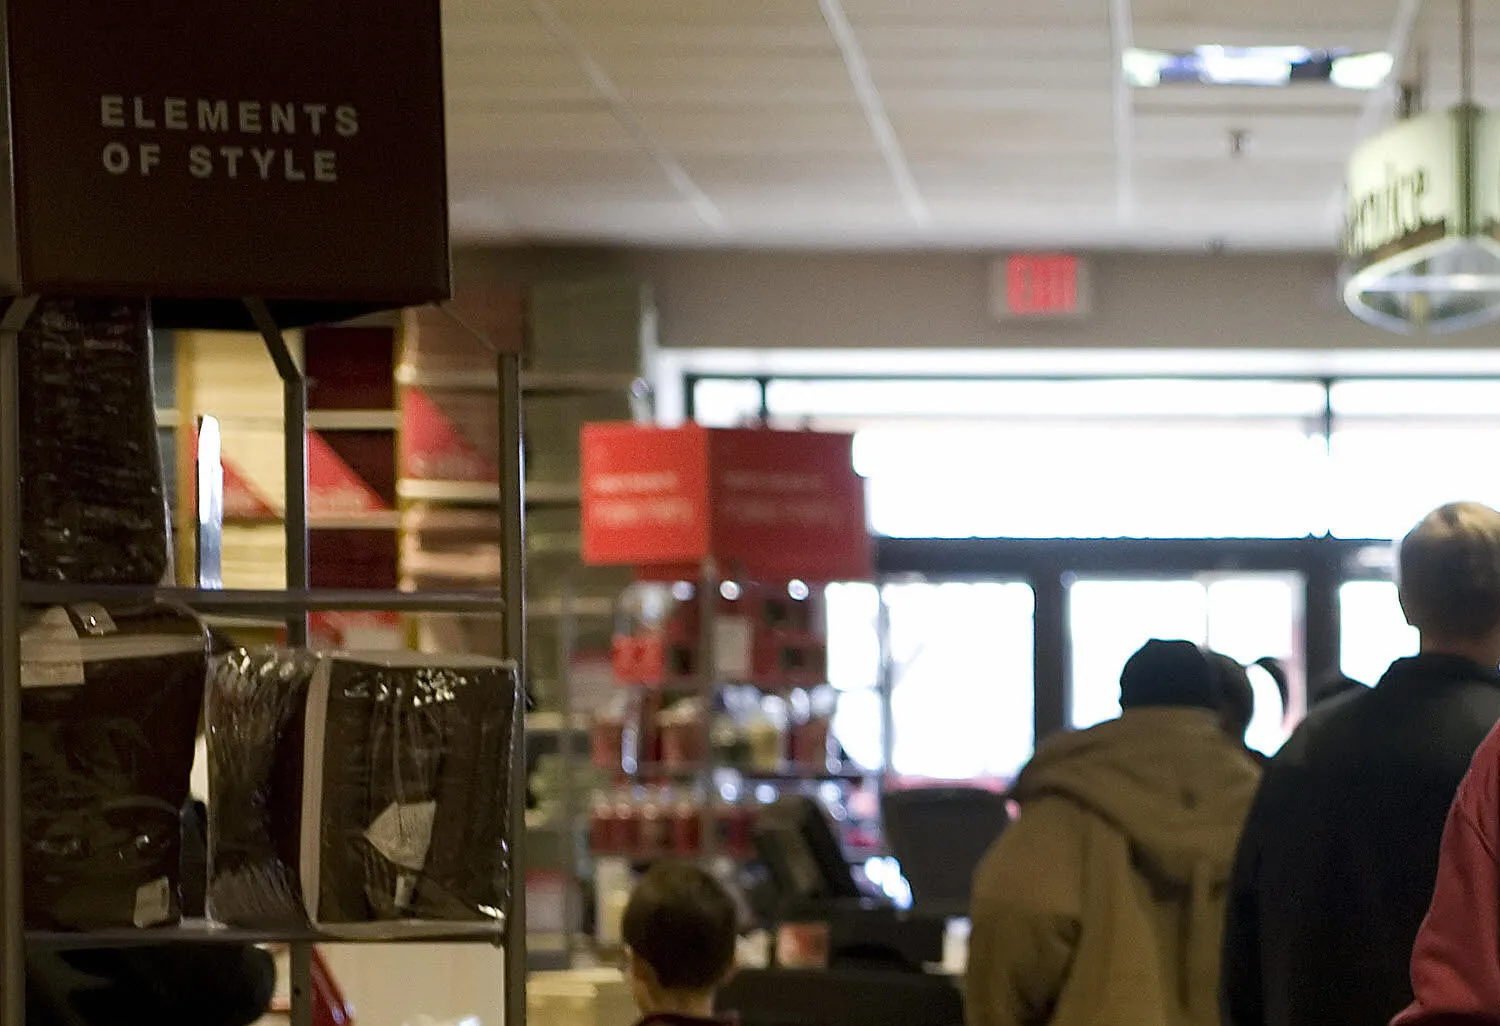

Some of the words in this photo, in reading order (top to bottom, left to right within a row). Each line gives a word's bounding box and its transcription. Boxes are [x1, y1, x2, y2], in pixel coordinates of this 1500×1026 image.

[101, 94, 359, 138] ELEMENTS
[102, 143, 161, 176] OF
[189, 146, 338, 182] STYLE
